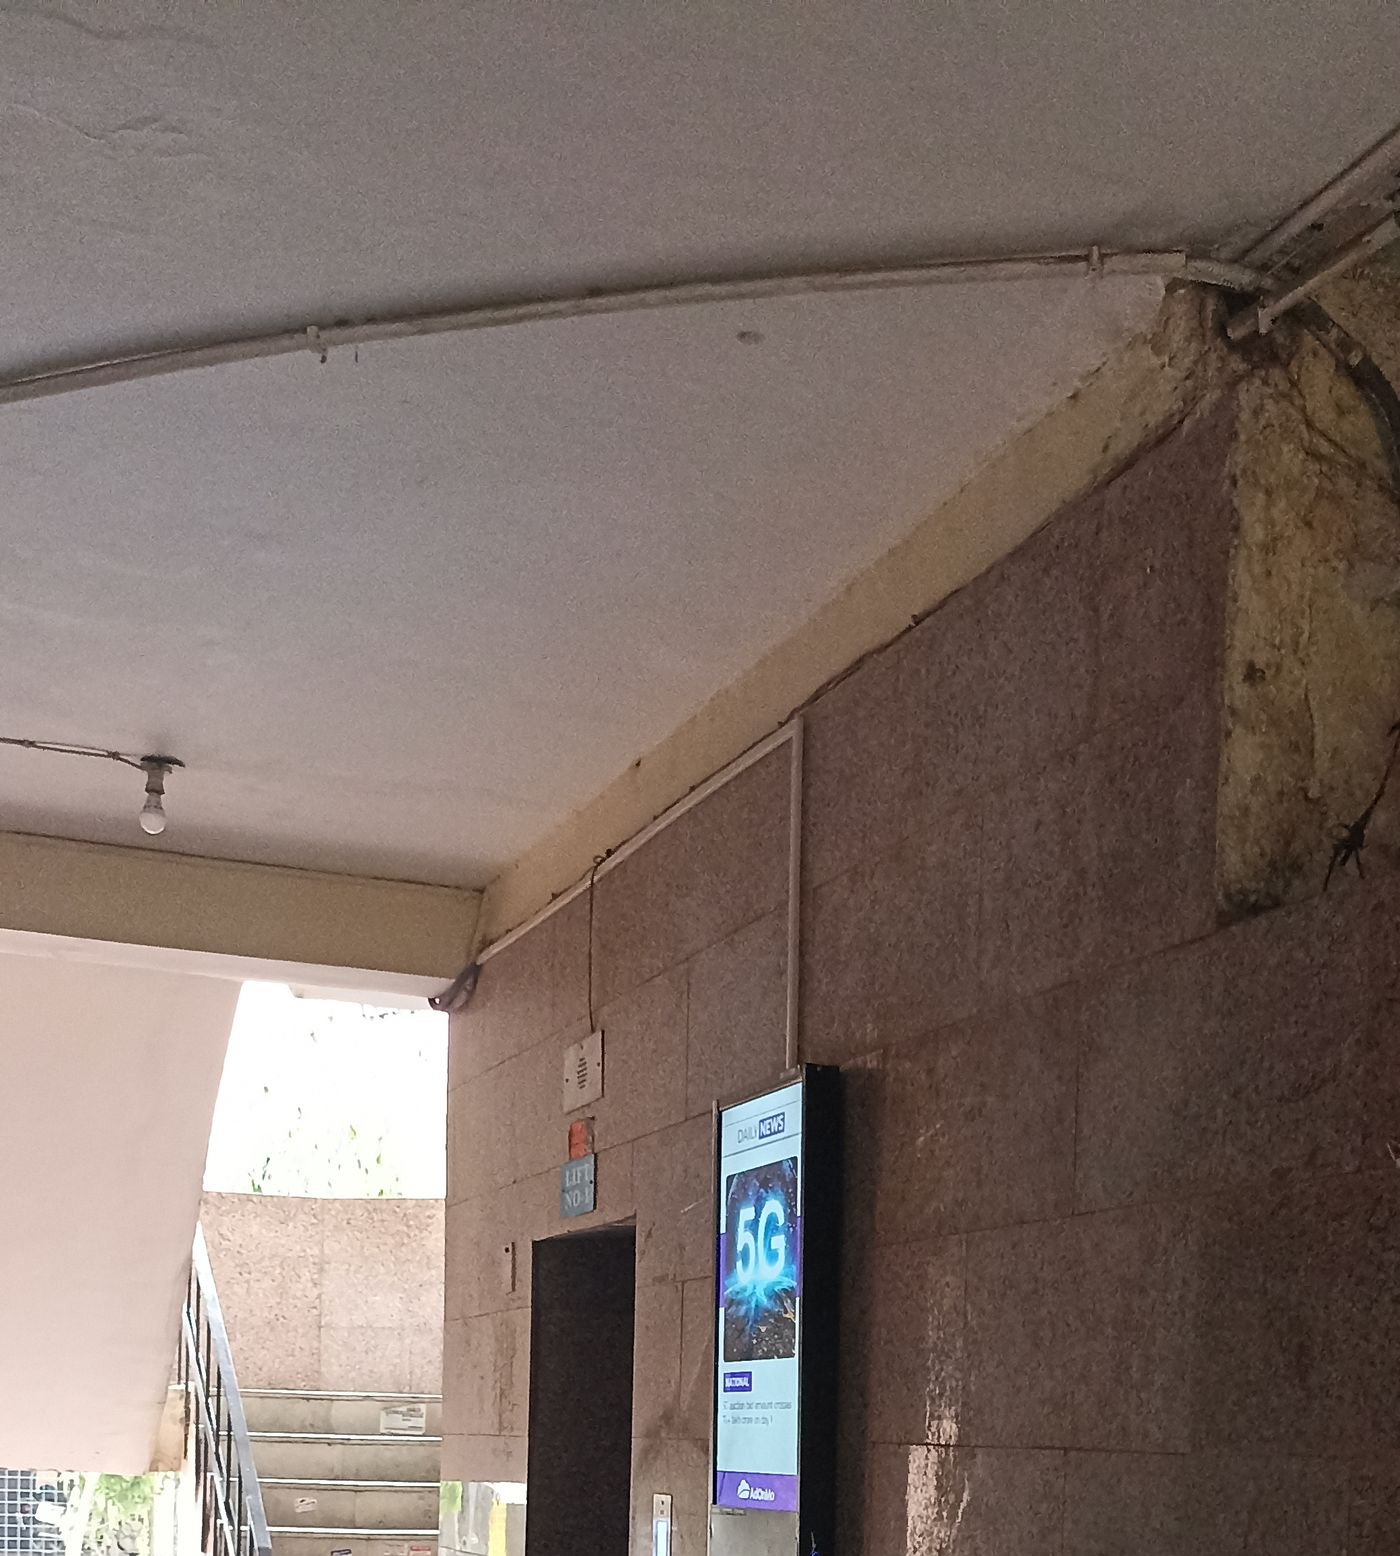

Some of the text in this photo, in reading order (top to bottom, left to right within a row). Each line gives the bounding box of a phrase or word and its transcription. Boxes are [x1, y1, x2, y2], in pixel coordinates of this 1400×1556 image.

[759, 1114, 784, 1137] NEWS
[565, 1164, 590, 1187] LIFT
[736, 1199, 786, 1284] 5G
